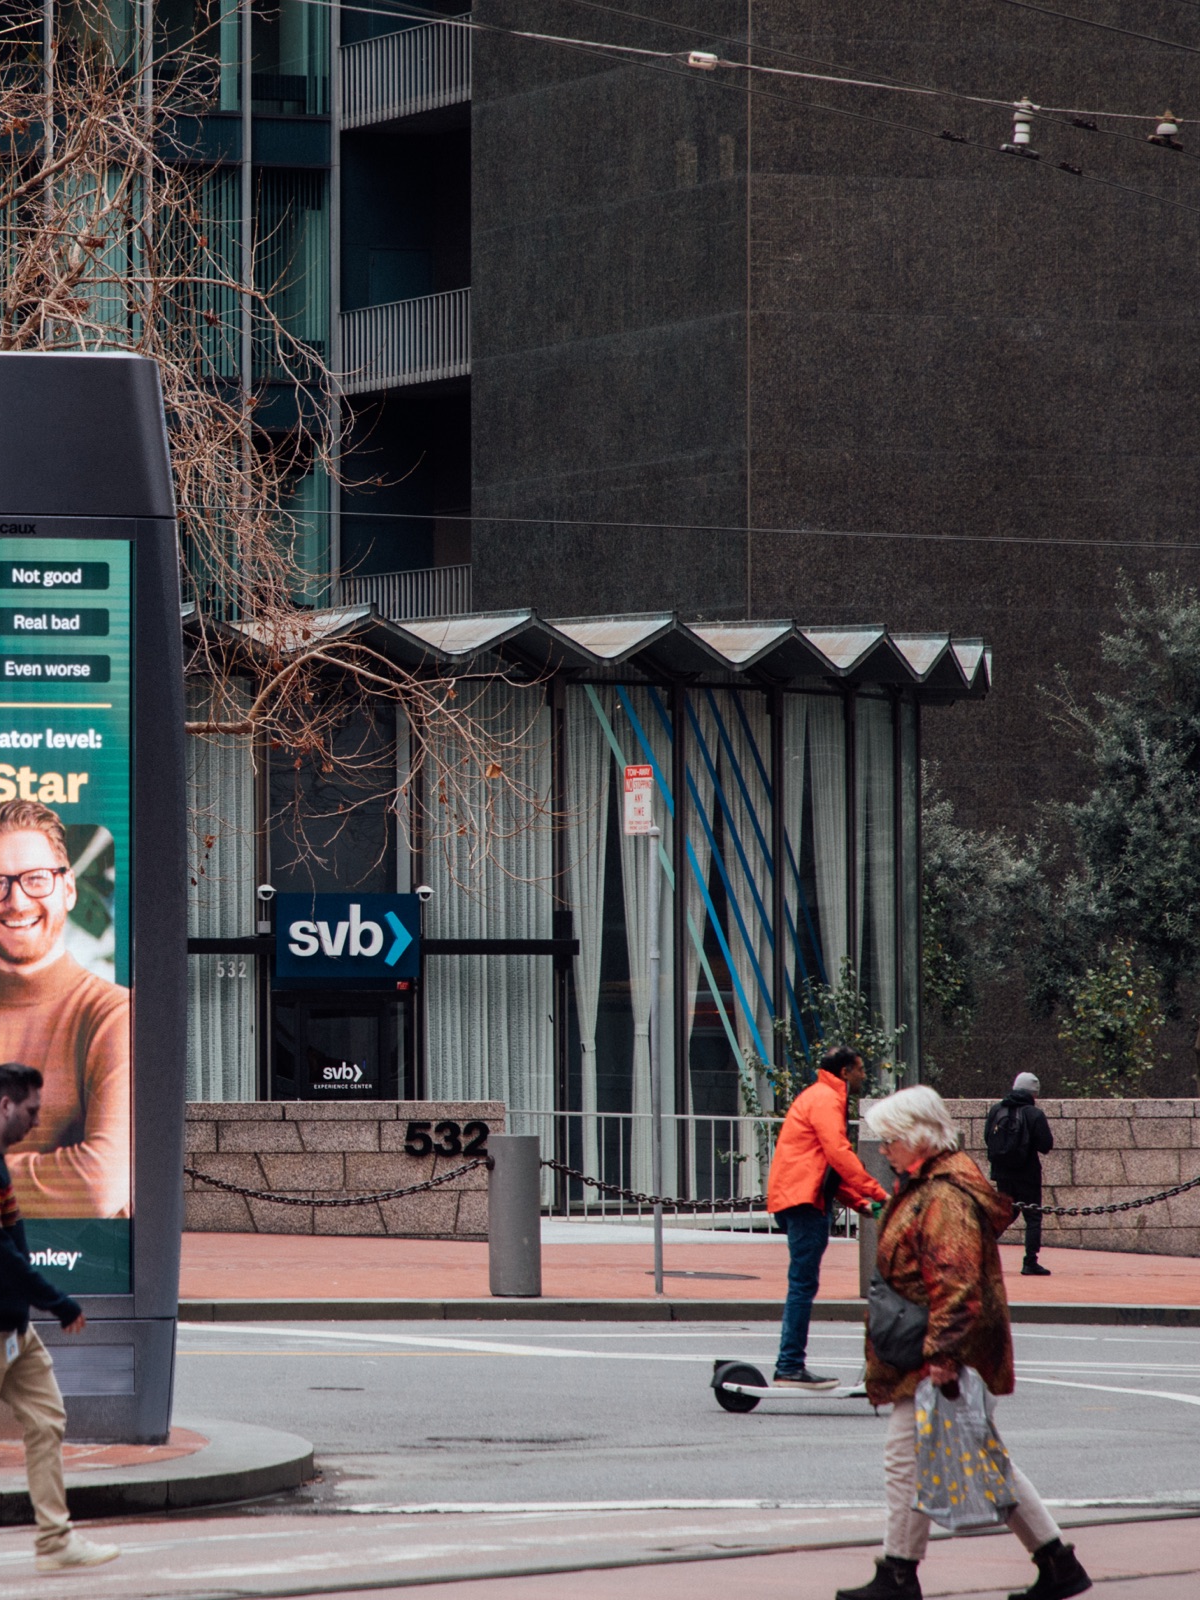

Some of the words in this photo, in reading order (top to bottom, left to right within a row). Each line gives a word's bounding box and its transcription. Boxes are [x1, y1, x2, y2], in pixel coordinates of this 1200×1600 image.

[11, 568, 41, 584] Not
[43, 568, 82, 588] good
[13, 615, 48, 630] Real
[51, 615, 80, 630] bad
[4, 661, 42, 676] Even
[45, 664, 91, 677] worse
[45, 729, 103, 749] level:
[288, 903, 384, 957] svb
[216, 961, 247, 978] 532
[322, 1061, 354, 1080] svb
[405, 1121, 490, 1156] 532
